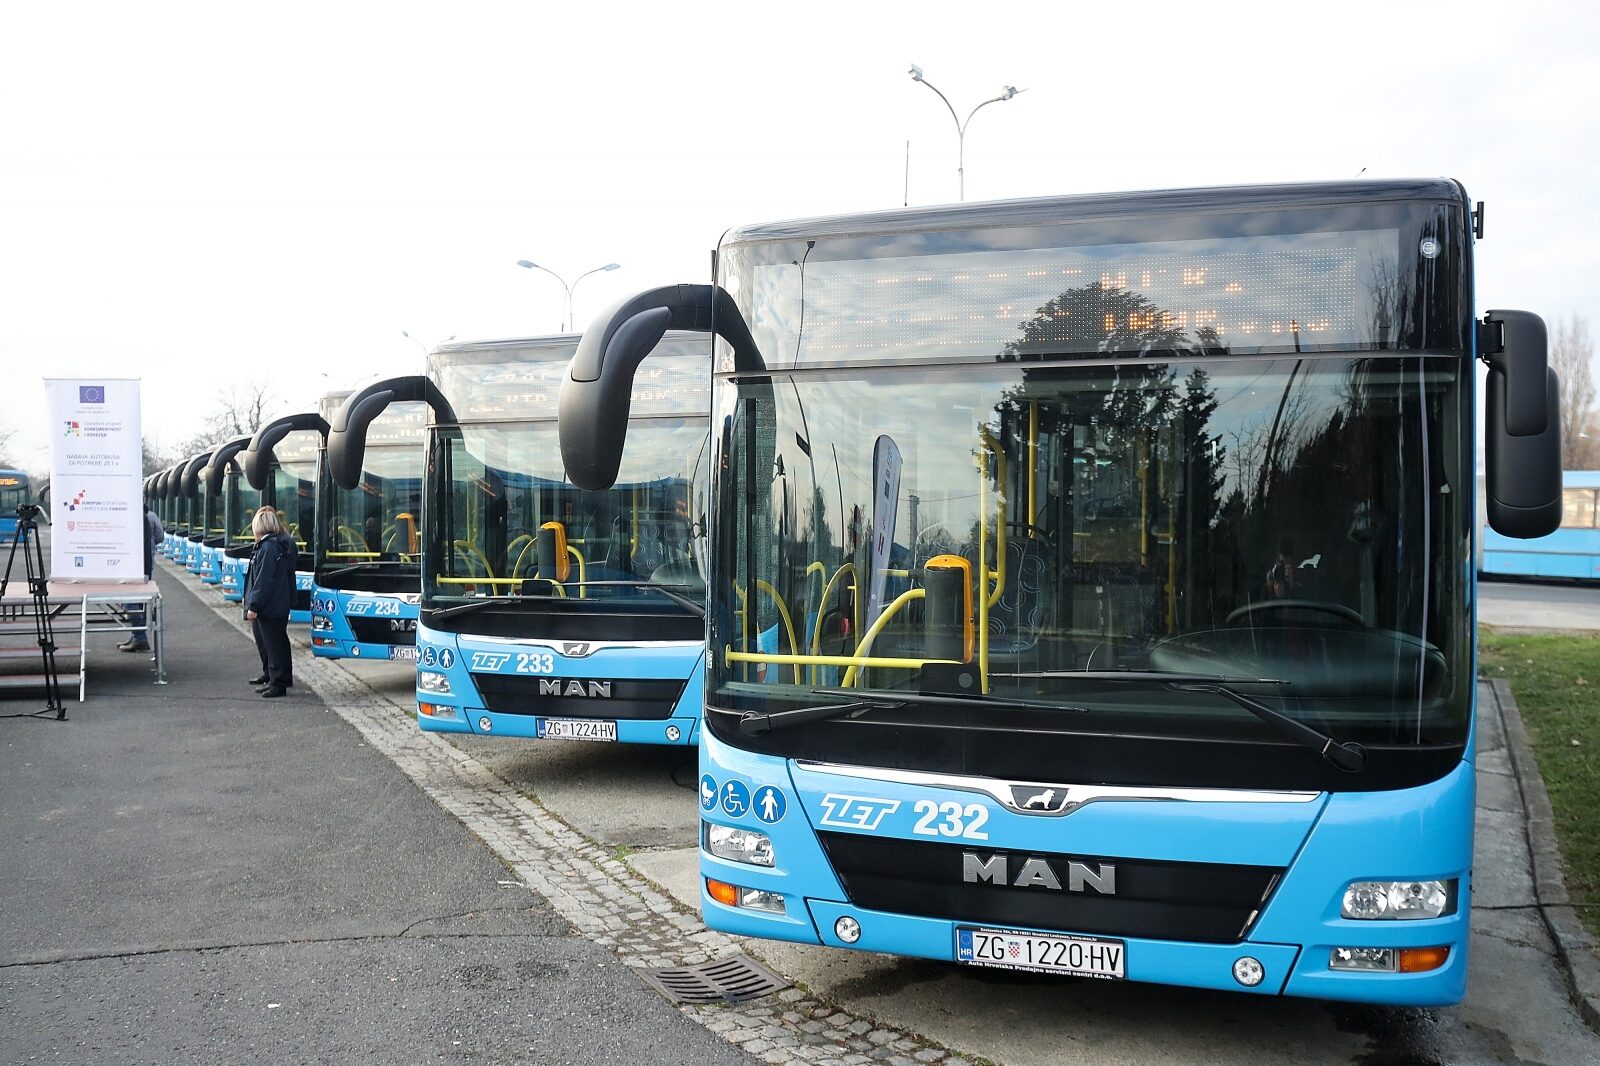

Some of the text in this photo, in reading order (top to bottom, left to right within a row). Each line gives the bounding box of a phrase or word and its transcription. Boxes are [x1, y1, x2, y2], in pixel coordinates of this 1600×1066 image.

[346, 601, 400, 615] ZET 234
[390, 619, 417, 631] MA
[471, 652, 554, 674] ZET 233
[539, 678, 612, 698] MAN
[546, 721, 561, 735] ZG
[819, 792, 989, 840] ZET 232
[962, 848, 1116, 895] MAN
[960, 947, 972, 956] HR
[975, 935, 1005, 960] ZG
[984, 961, 1014, 970] Hrvatska
[1014, 965, 1044, 973] Prodajno
[1045, 968, 1072, 976] servisni
